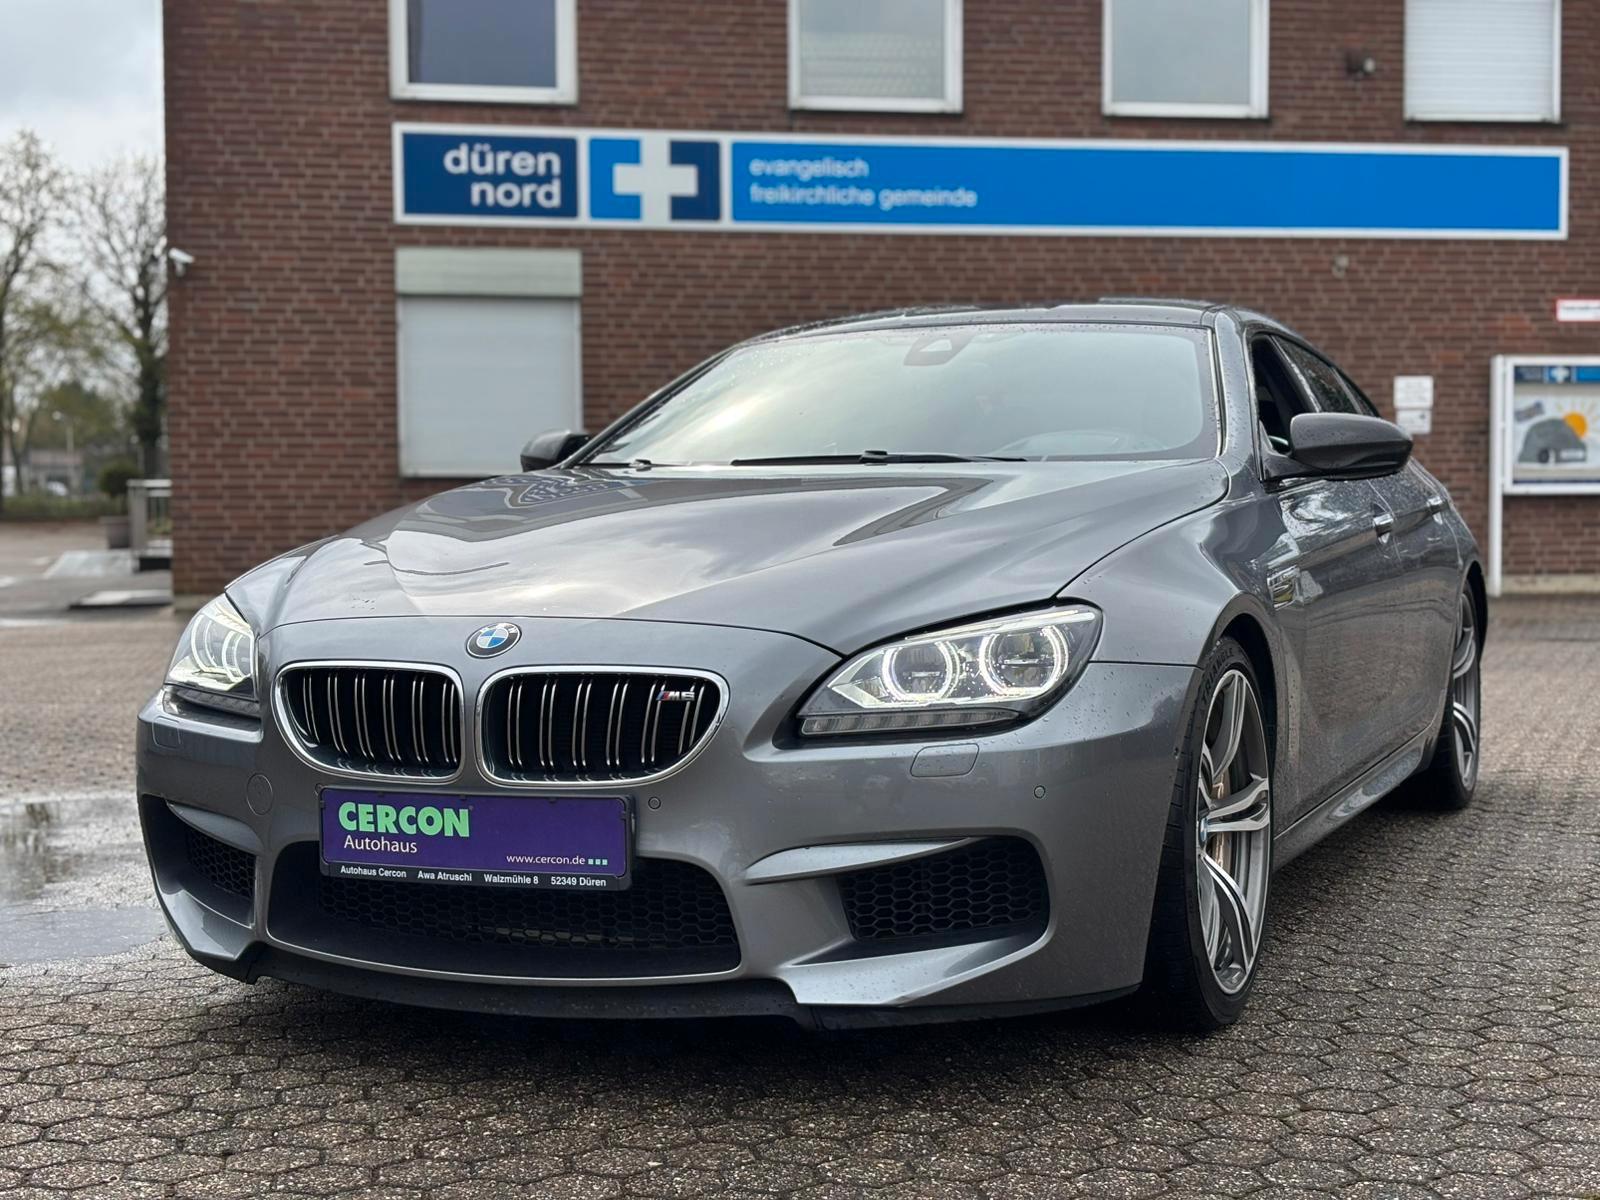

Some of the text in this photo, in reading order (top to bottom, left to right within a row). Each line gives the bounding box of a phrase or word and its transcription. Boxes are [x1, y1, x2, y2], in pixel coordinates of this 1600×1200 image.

[443, 142, 561, 176] düren
[750, 156, 870, 182] evangelisch
[470, 176, 562, 208] nord
[750, 181, 979, 212] freikirchliche gemeinde
[338, 801, 470, 838] CERCON
[343, 834, 418, 854] Autohaus
[506, 855, 586, 866] www.cercon.de
[340, 864, 607, 887] Autohaus Cercon Awa Atruschi Walzmühle 8 52349 Düren
